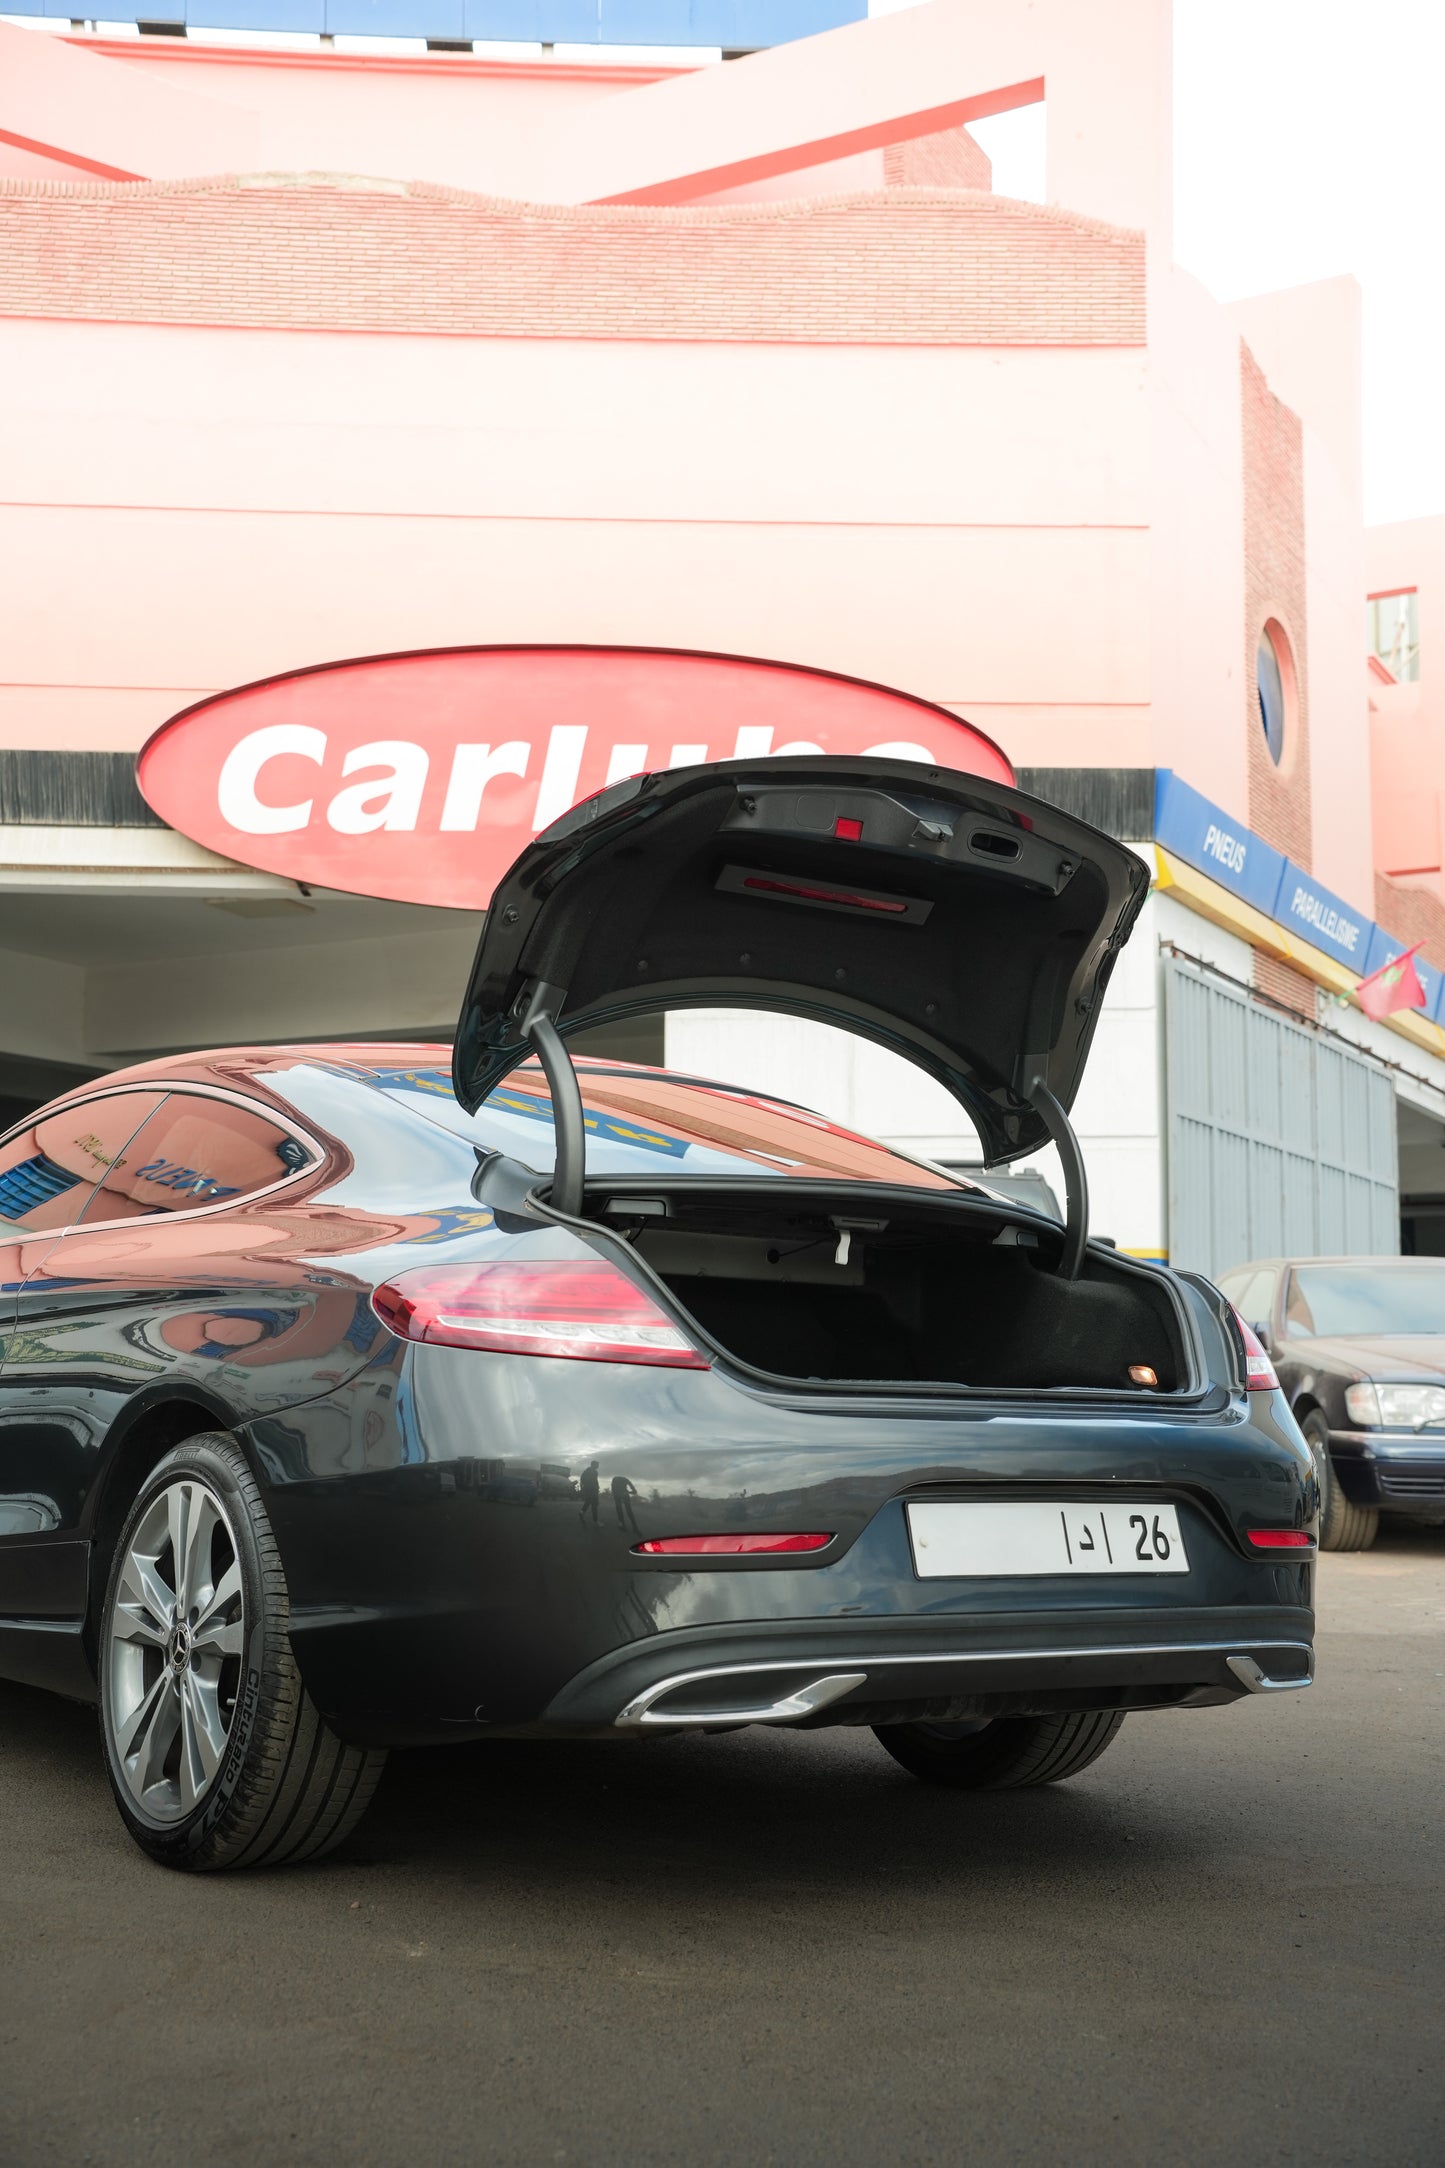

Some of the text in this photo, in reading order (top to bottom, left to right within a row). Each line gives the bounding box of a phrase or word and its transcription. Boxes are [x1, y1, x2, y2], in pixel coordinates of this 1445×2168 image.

[216, 724, 937, 835] Carl
[1202, 824, 1246, 873] PNEUS
[1290, 887, 1360, 952] PARALLELISME
[1129, 1514, 1170, 1561] 26
[201, 1788, 231, 1835] P7
